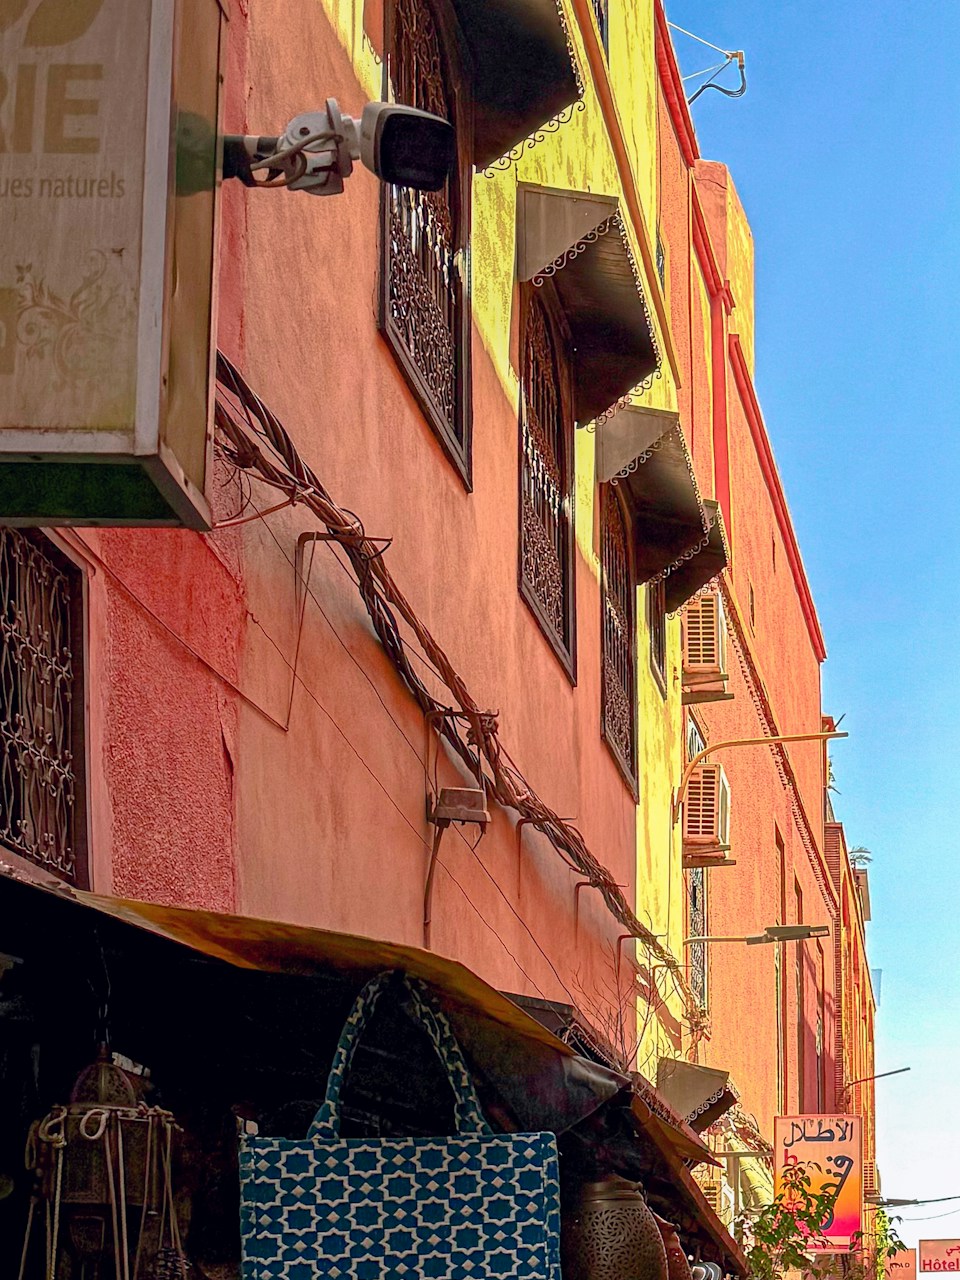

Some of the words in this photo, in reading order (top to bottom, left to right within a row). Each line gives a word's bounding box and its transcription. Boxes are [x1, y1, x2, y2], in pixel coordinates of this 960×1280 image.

[0, 63, 104, 154] IE
[39, 171, 126, 199] naturels
[922, 1258, 960, 1271] Hôtel
